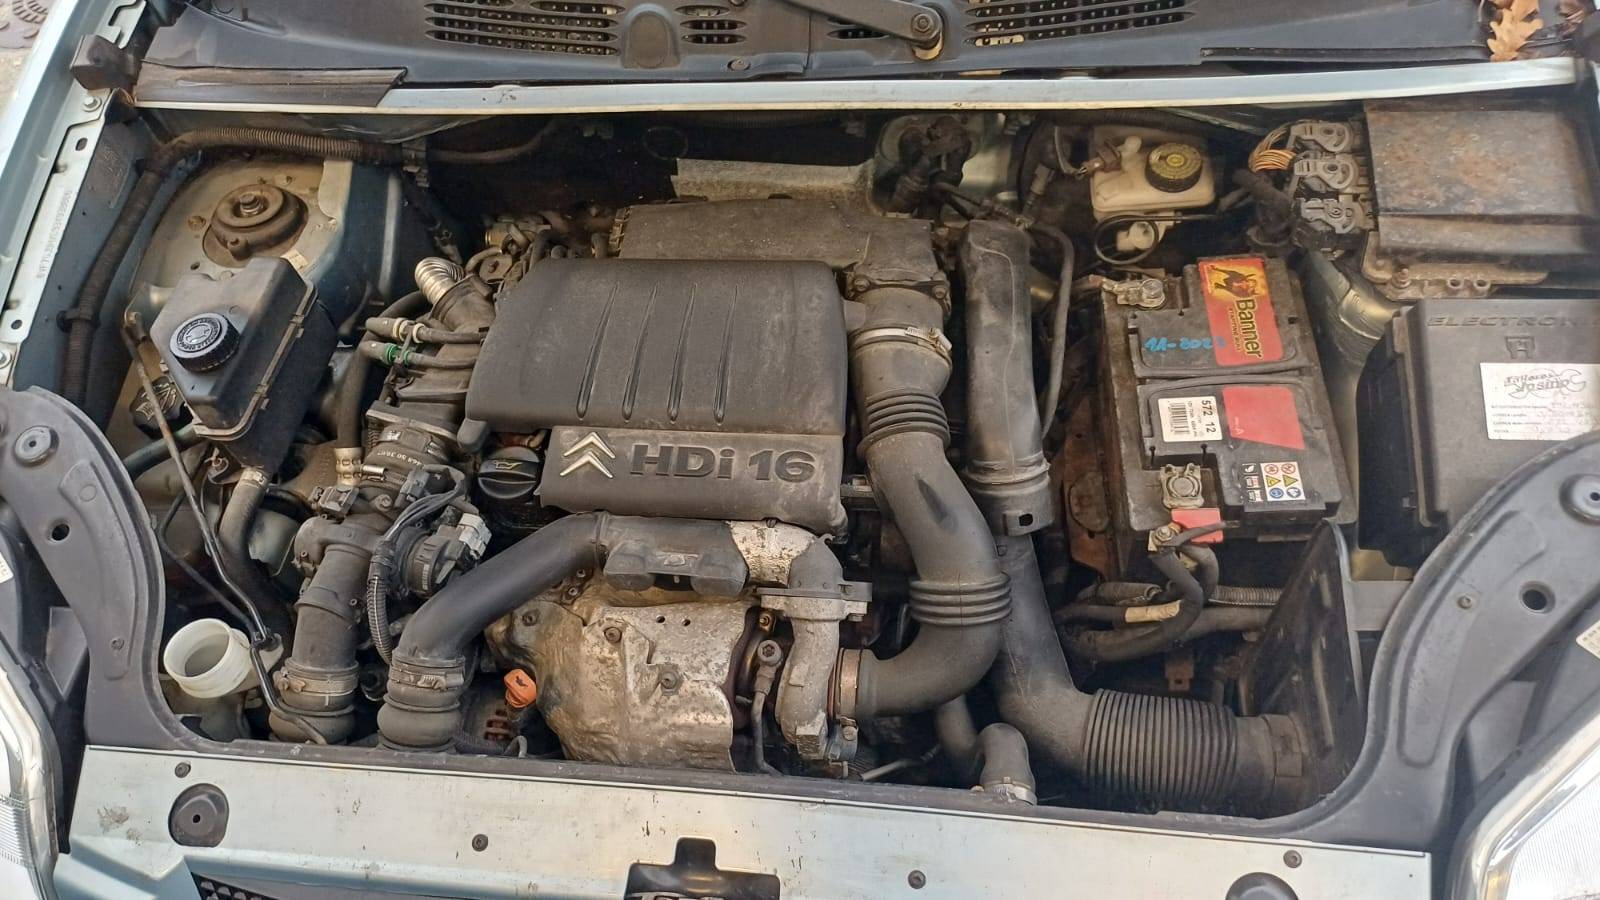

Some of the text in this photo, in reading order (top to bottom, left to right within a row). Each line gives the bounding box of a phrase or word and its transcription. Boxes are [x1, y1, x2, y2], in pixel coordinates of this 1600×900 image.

[1236, 298, 1262, 359] Banner
[1201, 400, 1217, 433] 572 12
[630, 443, 817, 483] HDi 16
